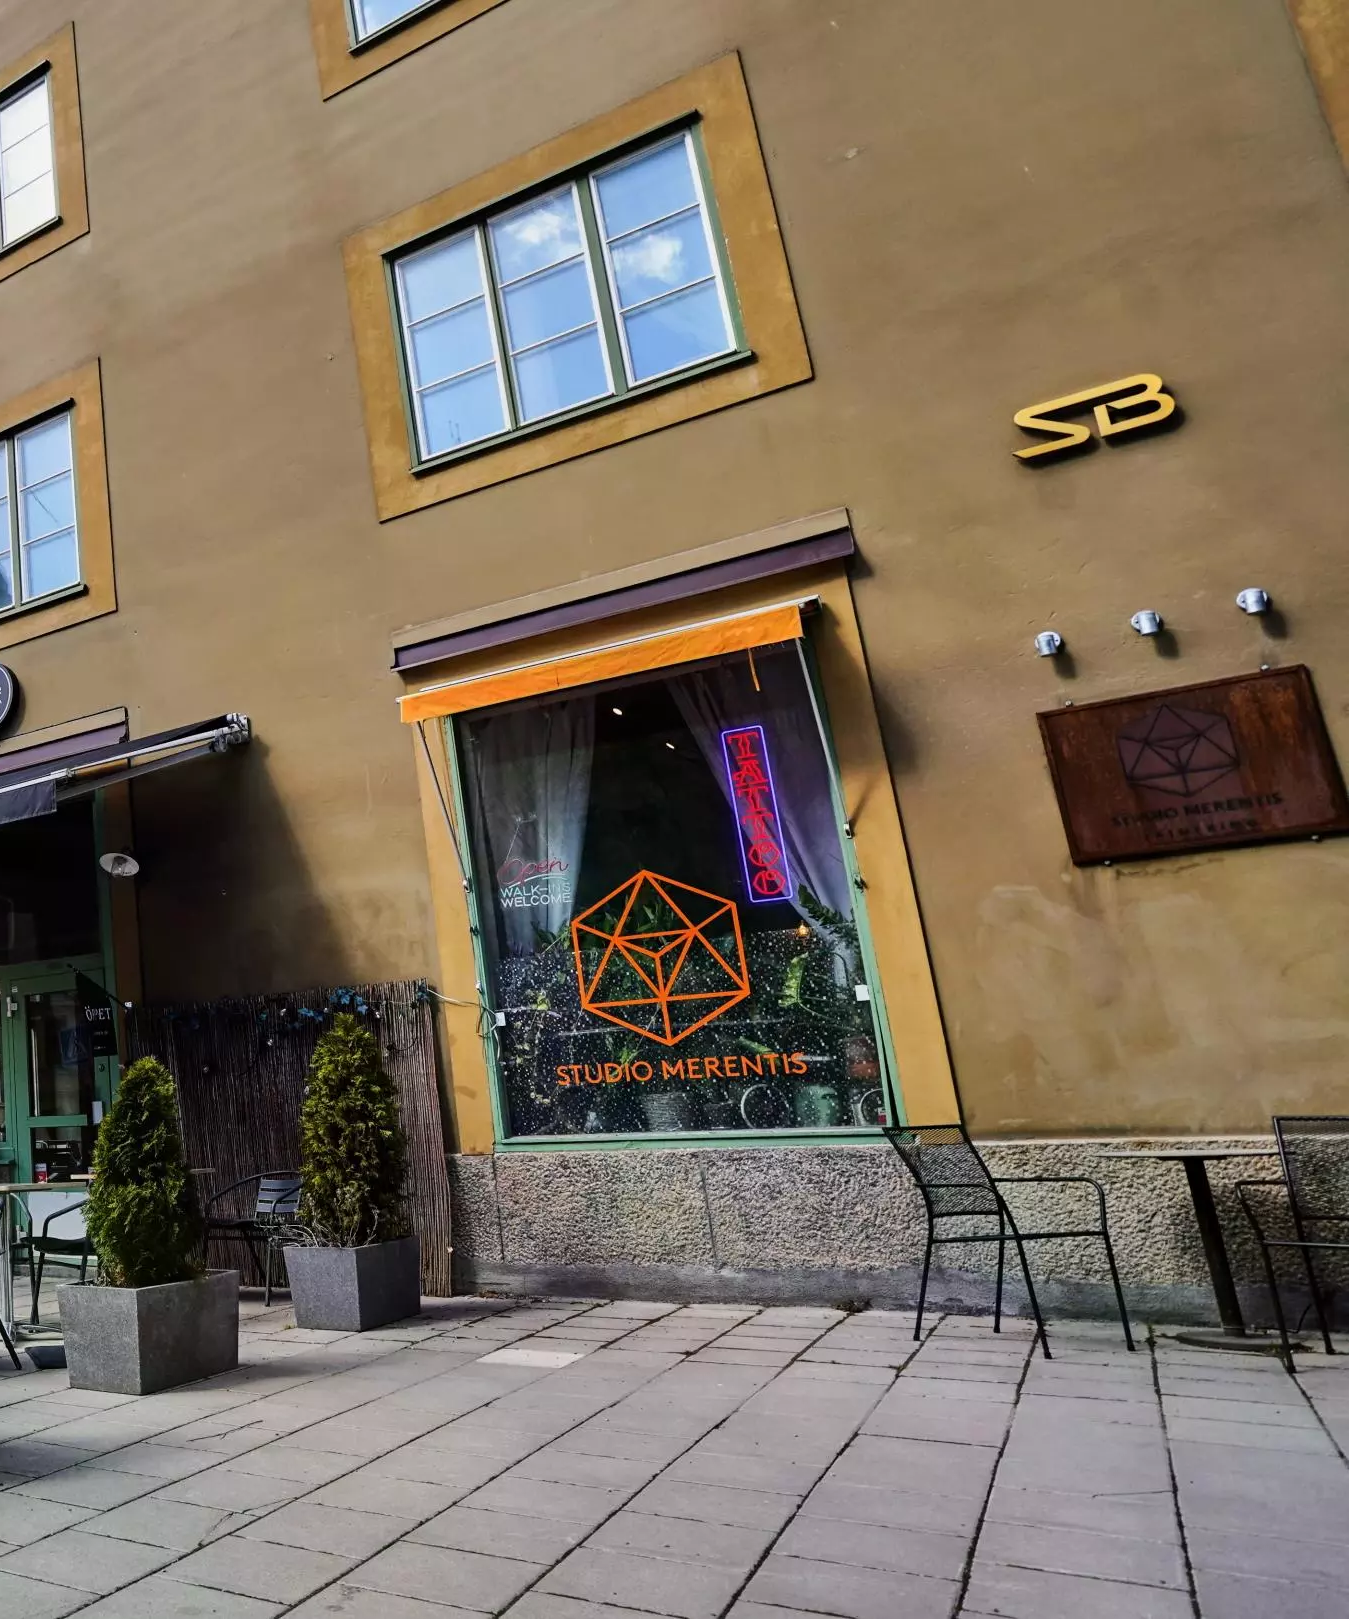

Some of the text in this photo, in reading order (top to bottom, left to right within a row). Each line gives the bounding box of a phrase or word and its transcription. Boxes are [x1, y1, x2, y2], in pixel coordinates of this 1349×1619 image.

[1012, 373, 1176, 459] SB
[726, 731, 786, 895] TATTOO
[496, 857, 569, 887] Open
[500, 882, 571, 898] WALK-INS
[500, 893, 573, 908] WELCOME
[556, 1051, 808, 1086] STUDIO MERENTIS
